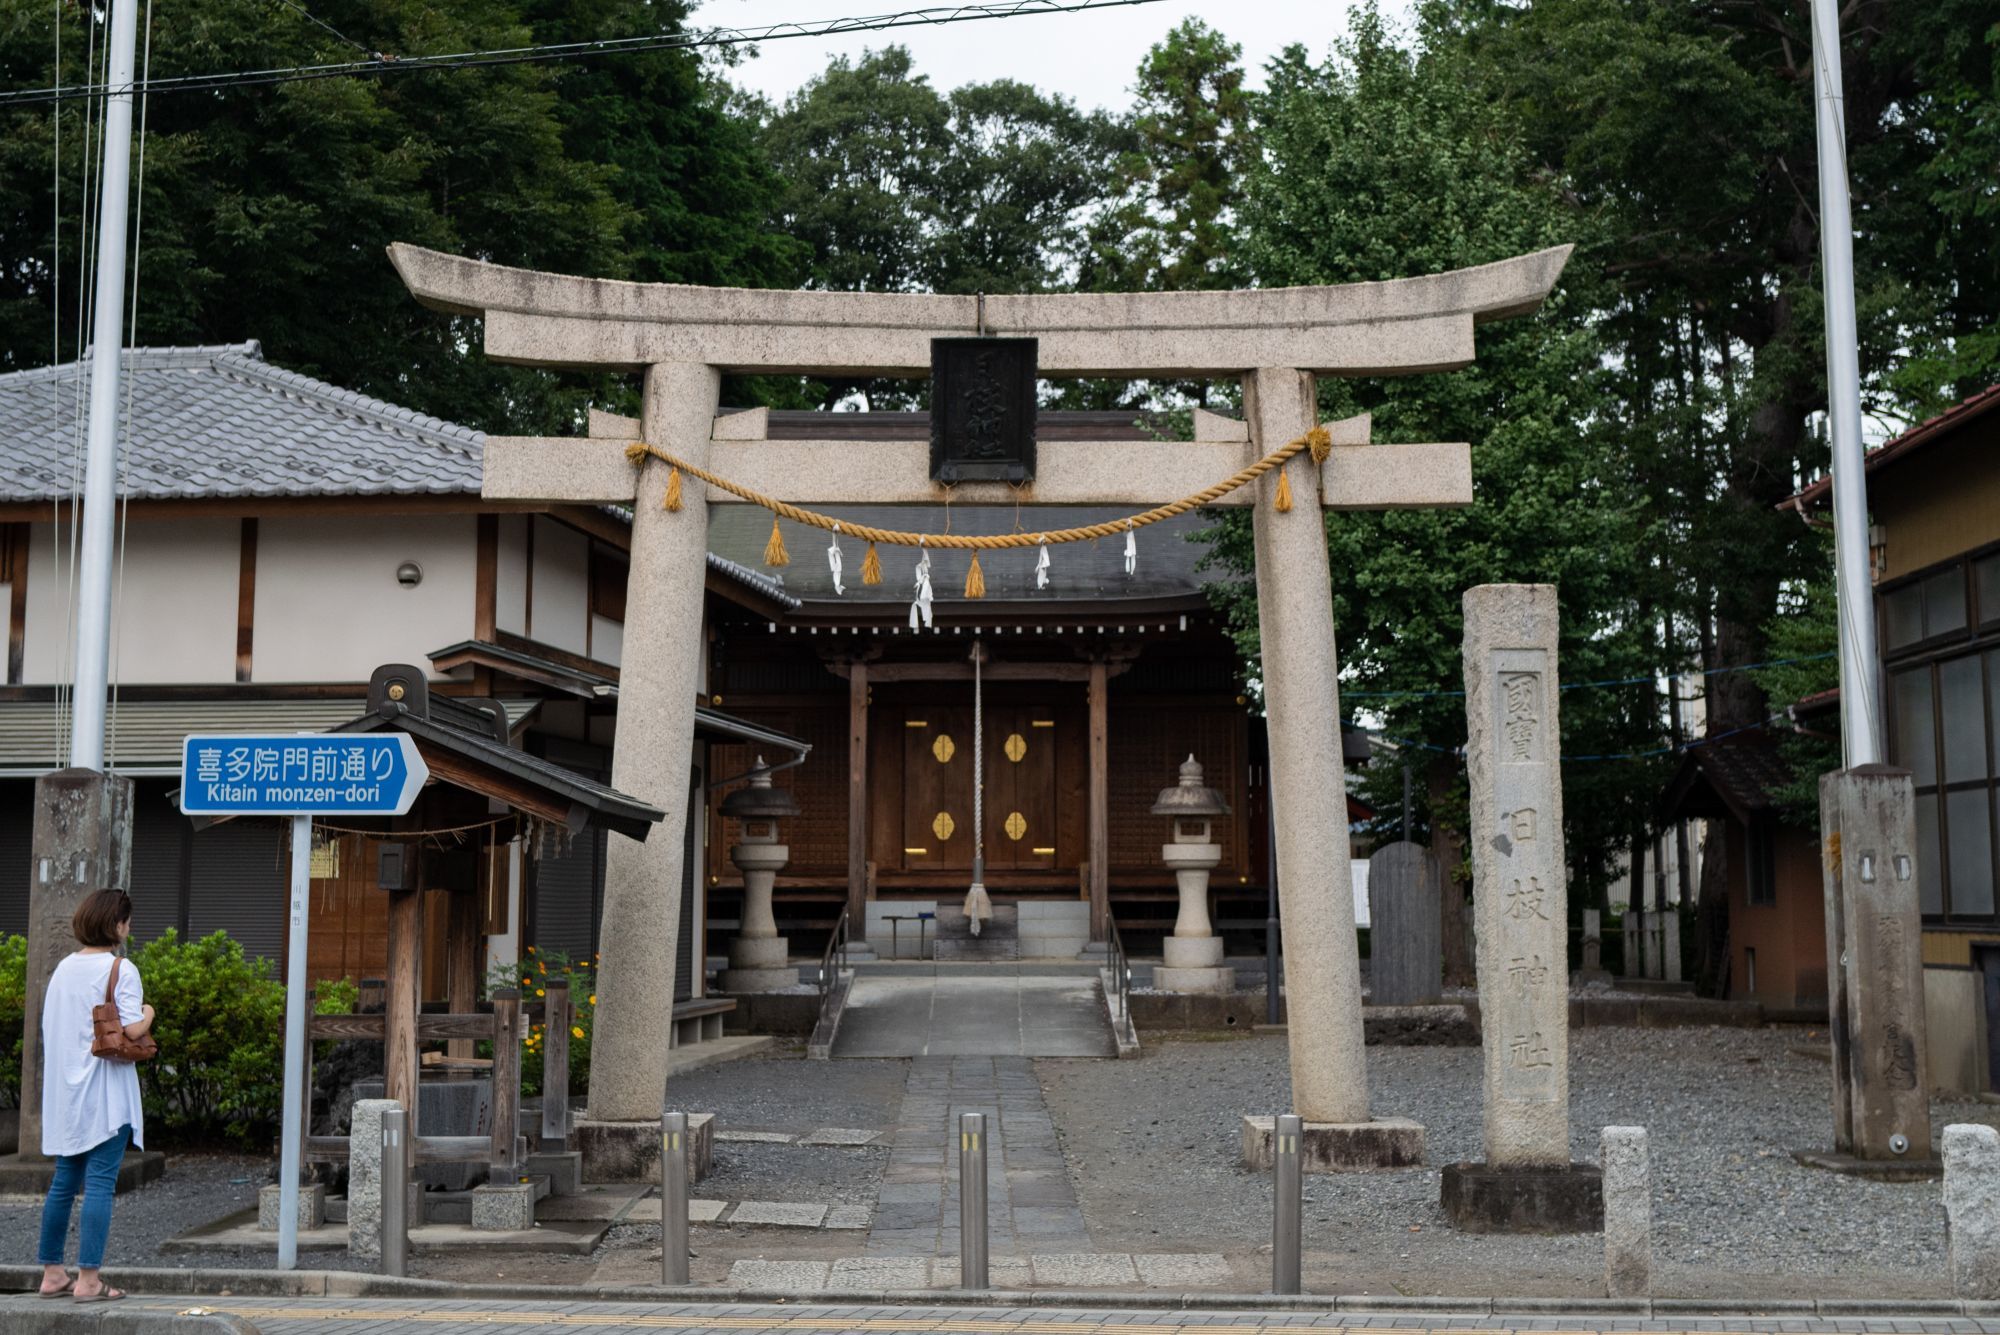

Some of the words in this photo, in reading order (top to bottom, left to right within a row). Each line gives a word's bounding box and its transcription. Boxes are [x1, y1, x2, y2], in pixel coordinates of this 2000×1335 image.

[196, 746, 394, 783] 喜多院門前通り
[207, 783, 257, 802] Kitain
[266, 783, 380, 802] monzen-dori
[1504, 807, 1552, 1072] 日枝神社
